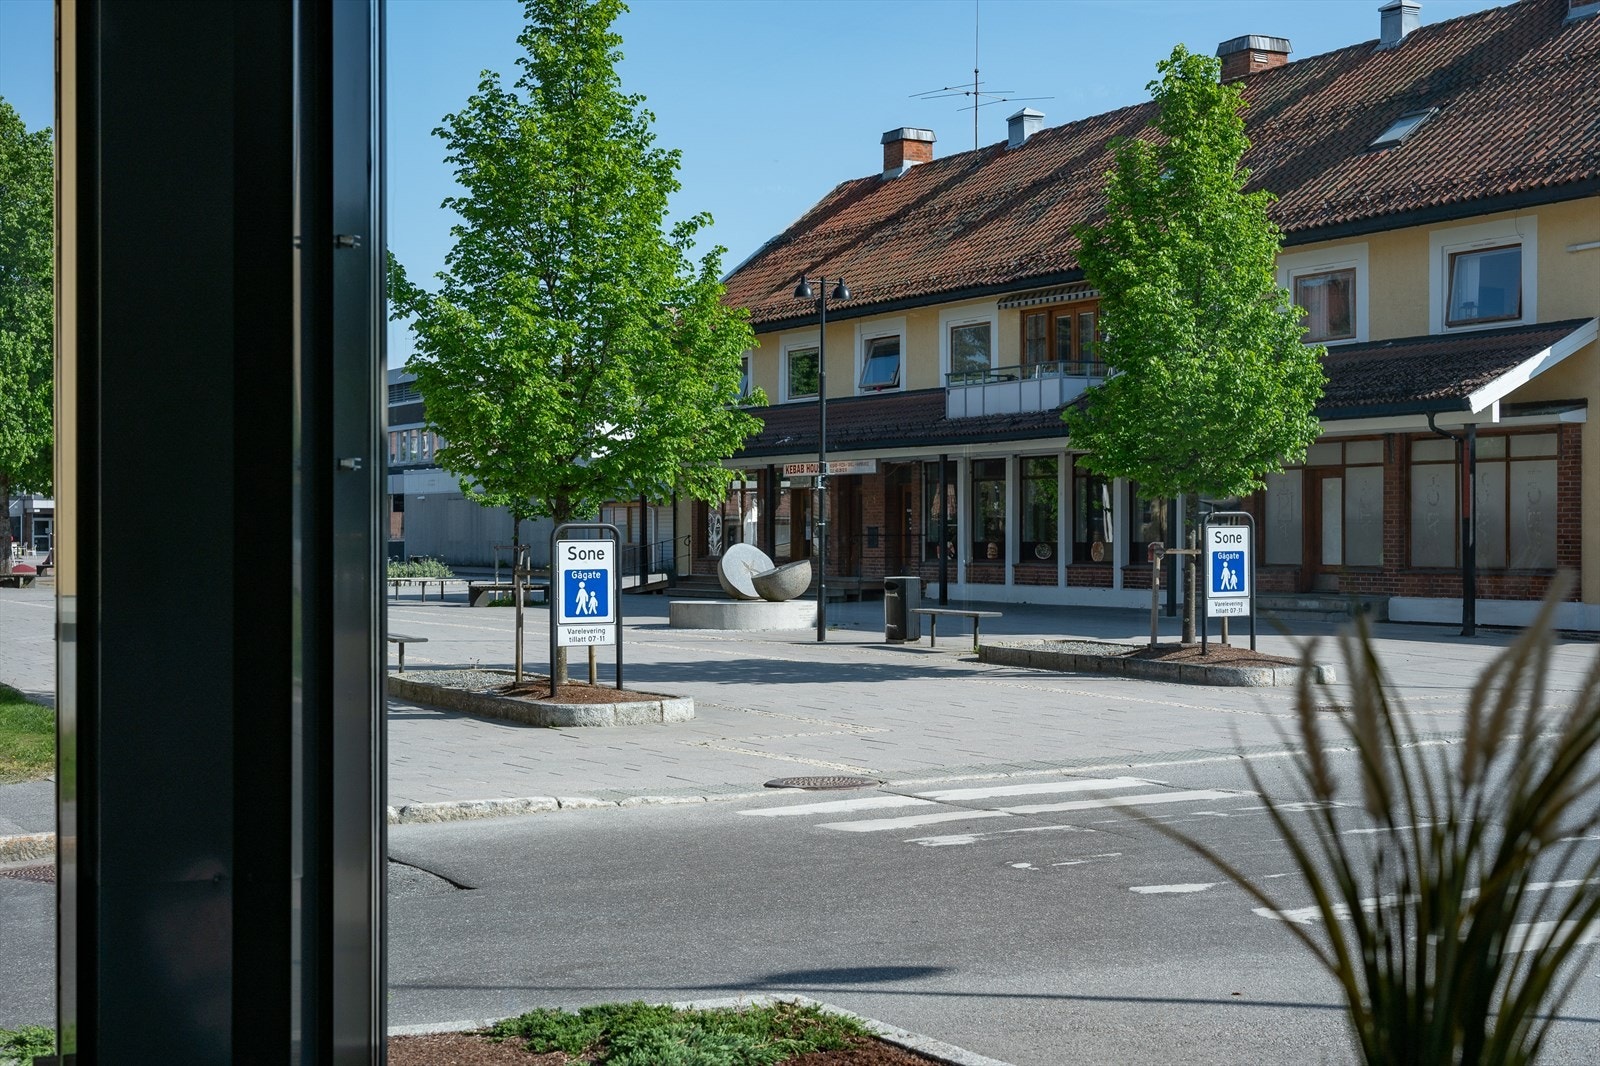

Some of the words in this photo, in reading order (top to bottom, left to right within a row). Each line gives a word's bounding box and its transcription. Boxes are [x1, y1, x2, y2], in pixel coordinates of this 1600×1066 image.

[785, 464, 804, 474] KEBAB
[806, 463, 820, 473] HOU
[1214, 531, 1242, 544] Sone
[568, 546, 604, 560] Sone
[1218, 552, 1240, 560] Gågate
[572, 570, 601, 580] Gågate
